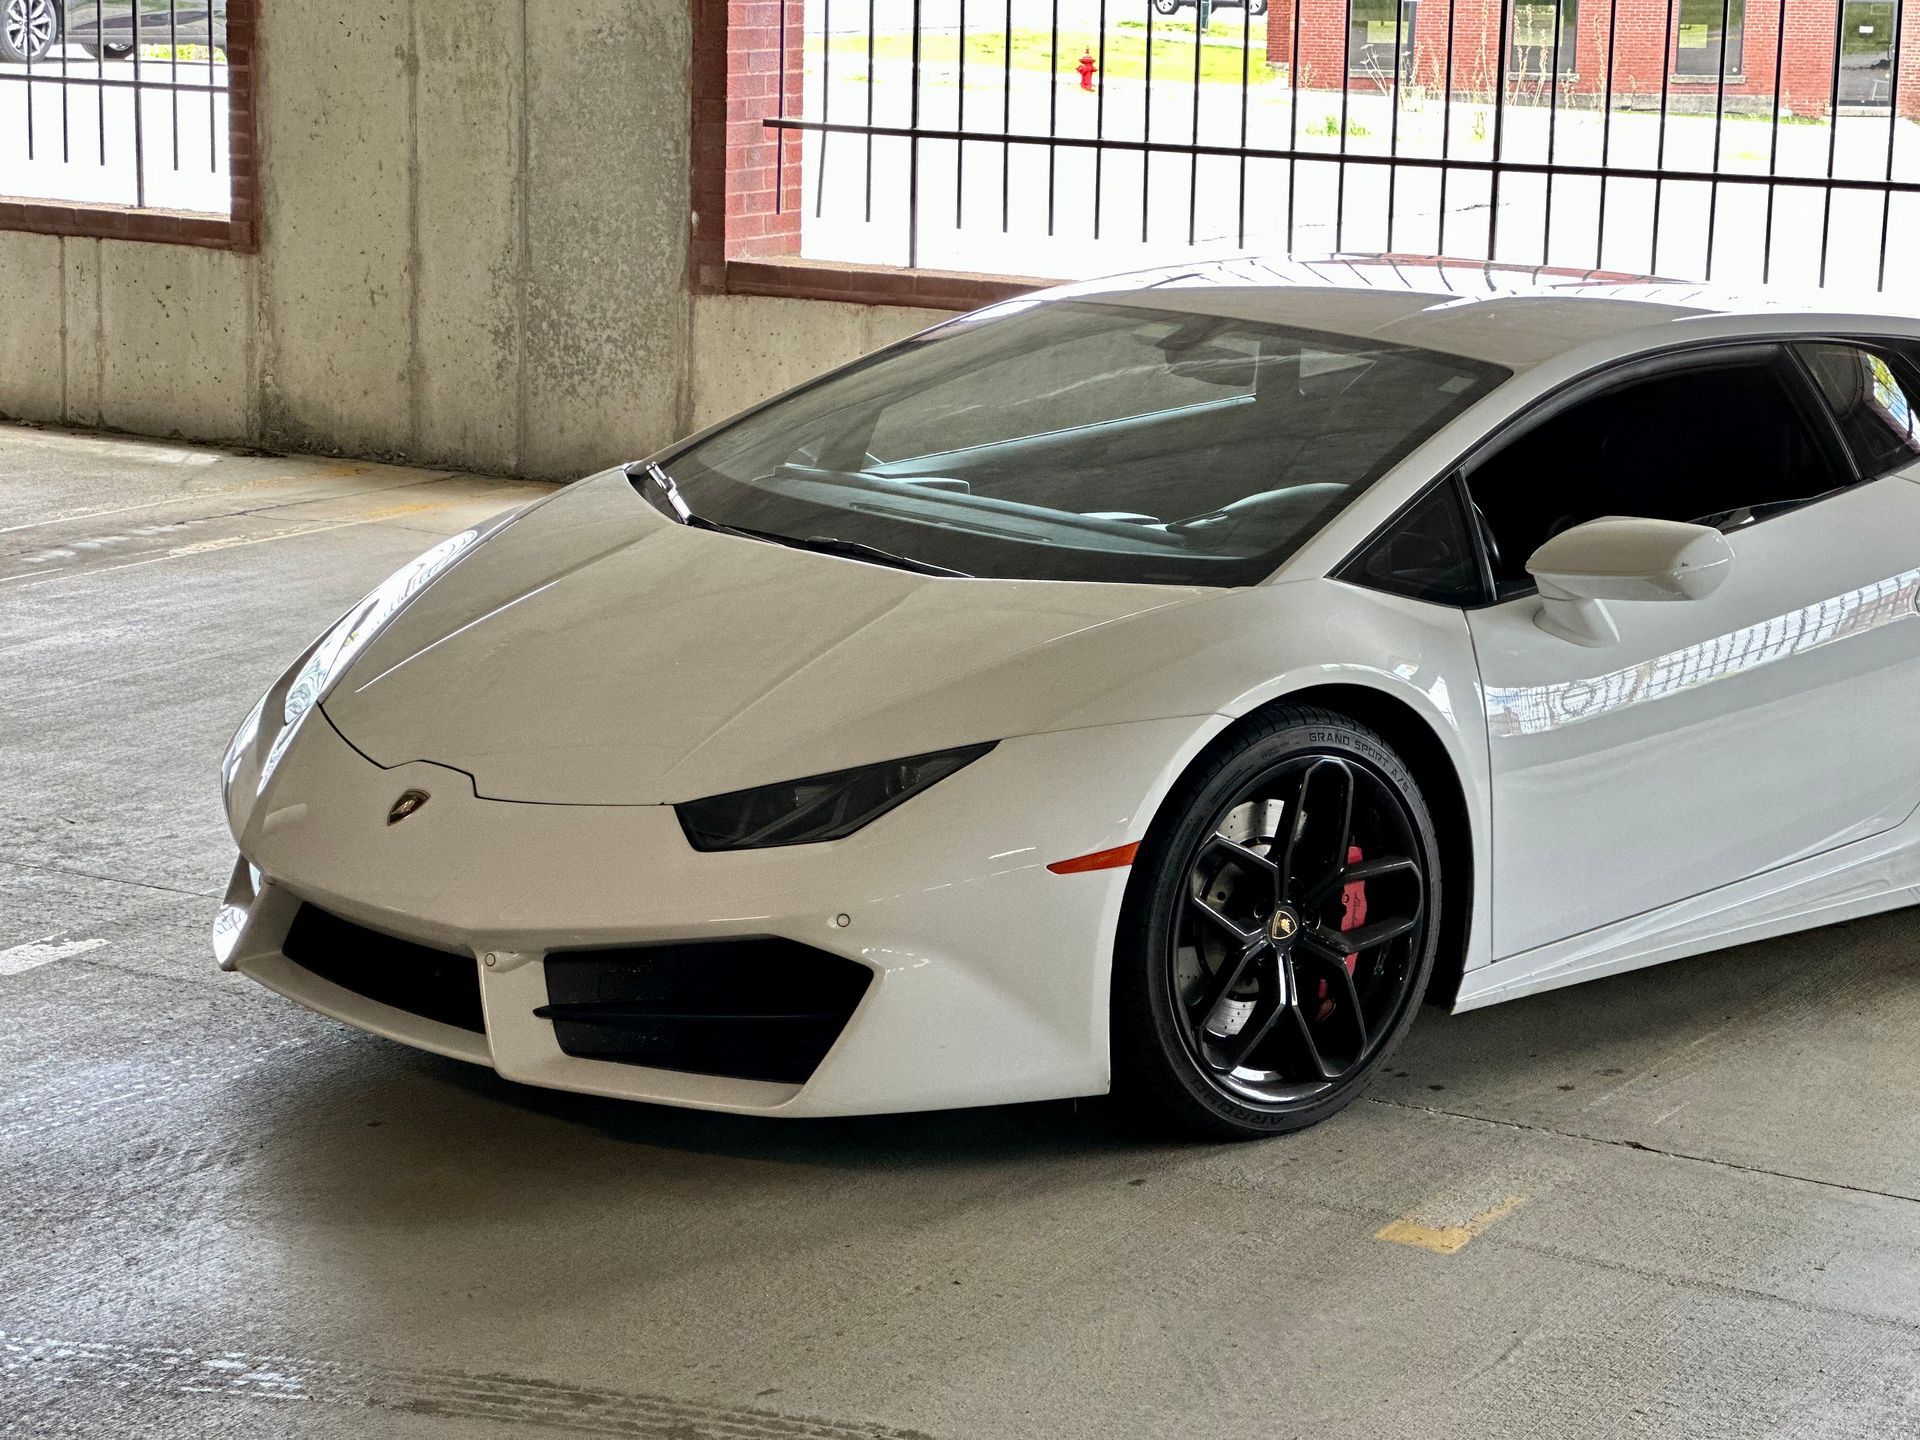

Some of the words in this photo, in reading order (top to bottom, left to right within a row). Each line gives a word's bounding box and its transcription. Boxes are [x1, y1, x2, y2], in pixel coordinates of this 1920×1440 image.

[1309, 732, 1350, 746] GRAND
[1354, 741, 1389, 767] SPORT
[1390, 768, 1410, 793] A/S
